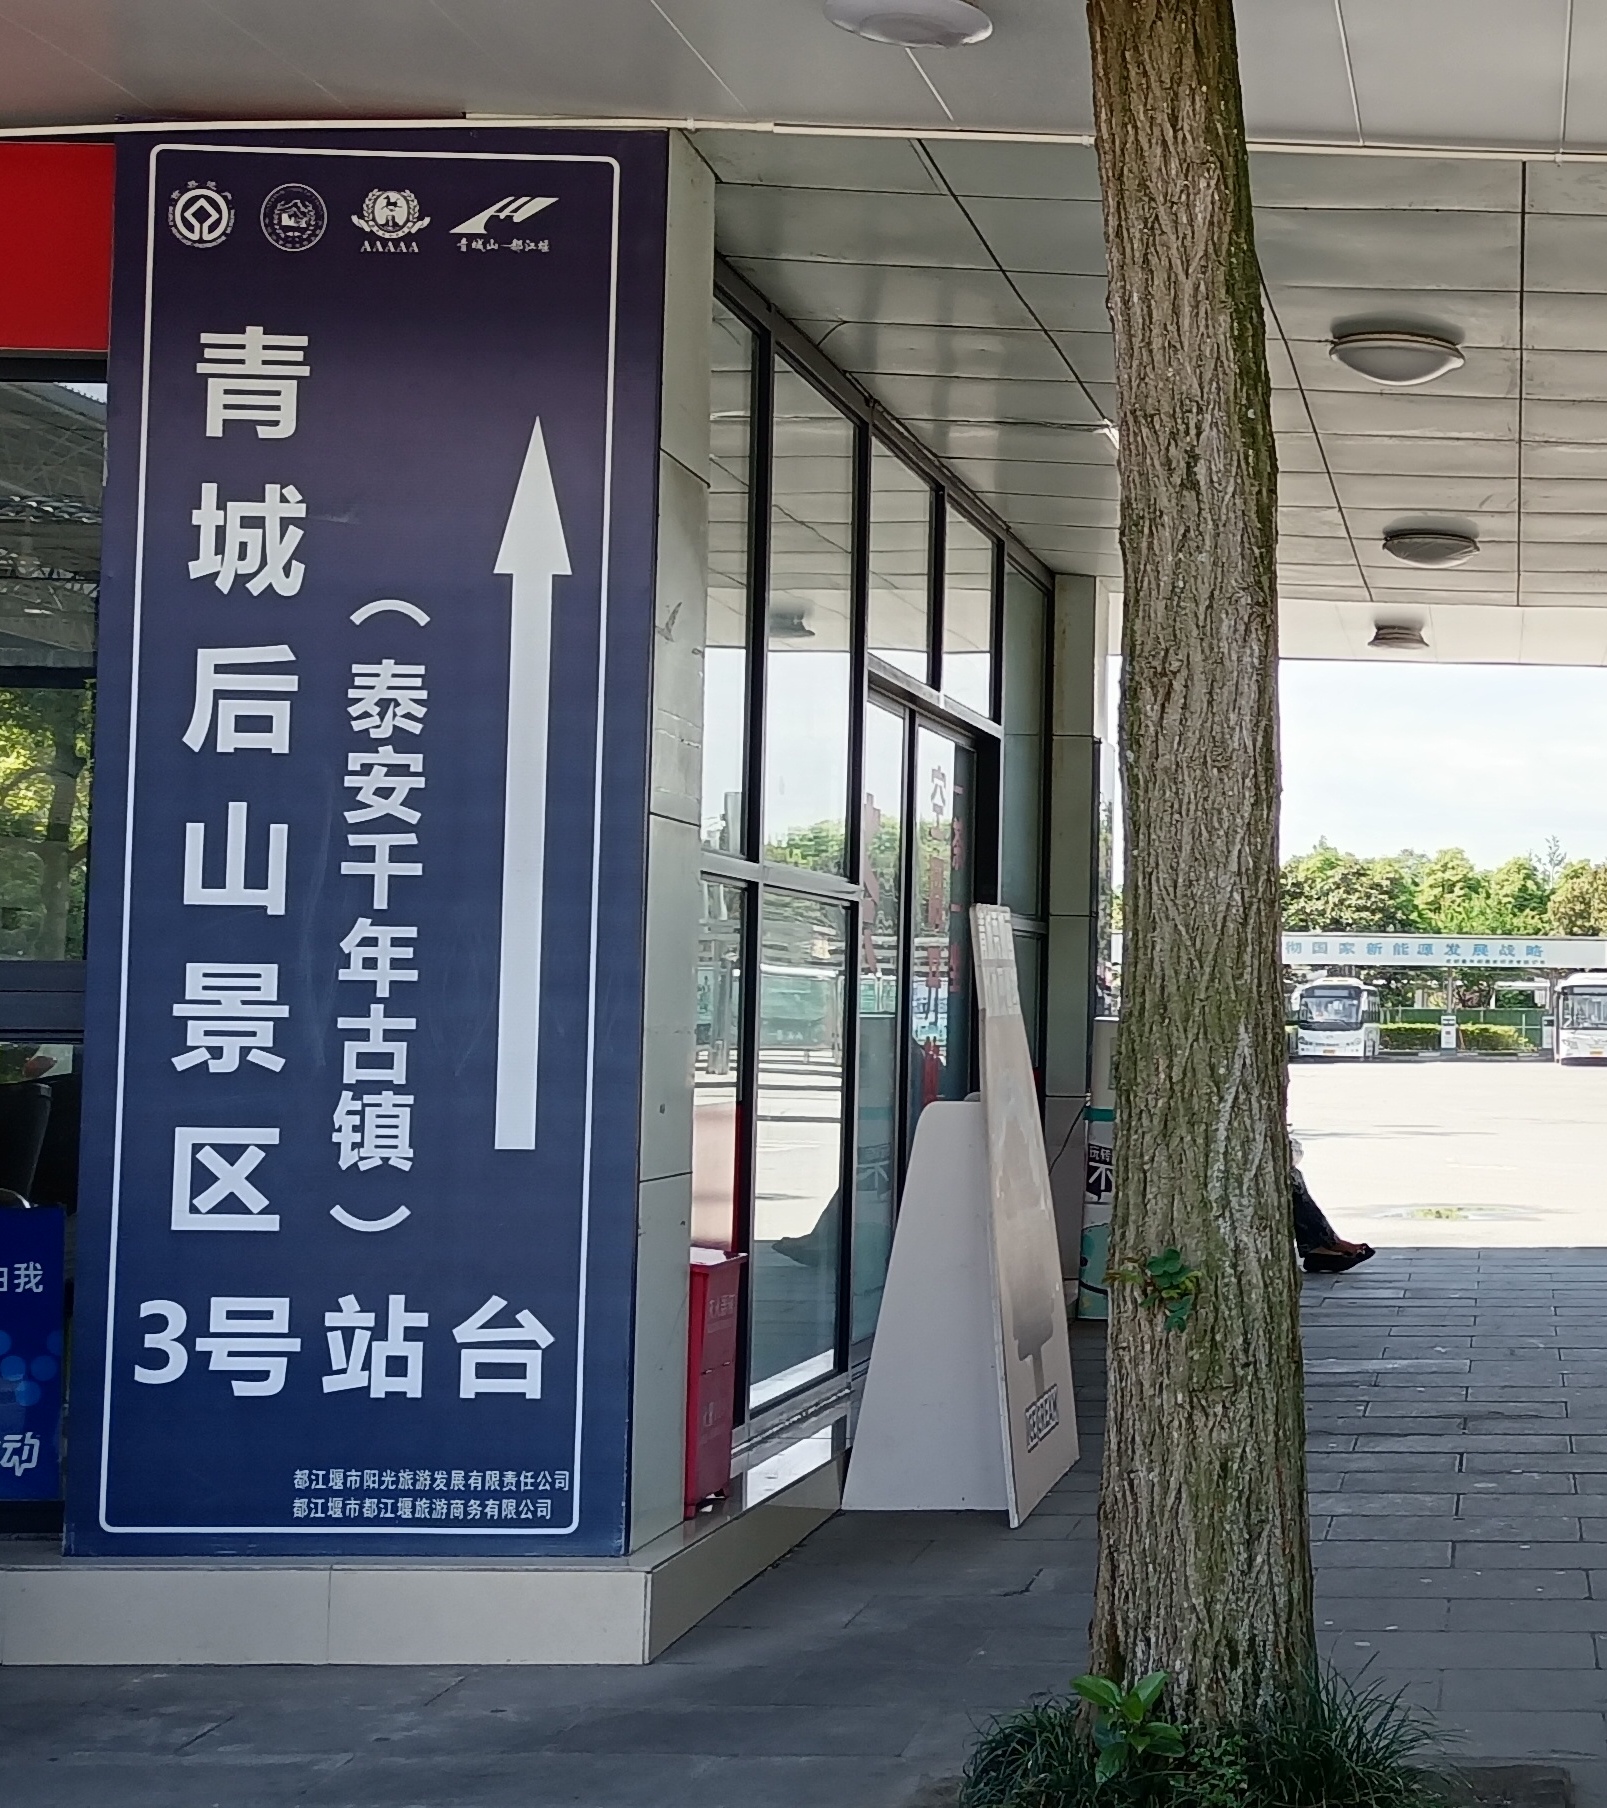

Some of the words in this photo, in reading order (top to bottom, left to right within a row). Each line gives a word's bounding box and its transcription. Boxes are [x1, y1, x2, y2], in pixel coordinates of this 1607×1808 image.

[170, 325, 311, 1231] 青城后山景区
[133, 1294, 556, 1400] 3号站台
[292, 1497, 552, 1519] 都江堰市都江堰旅游商务有限公司
[293, 1469, 570, 1491] 都江堰市阳光旅游发展有限责任公司
